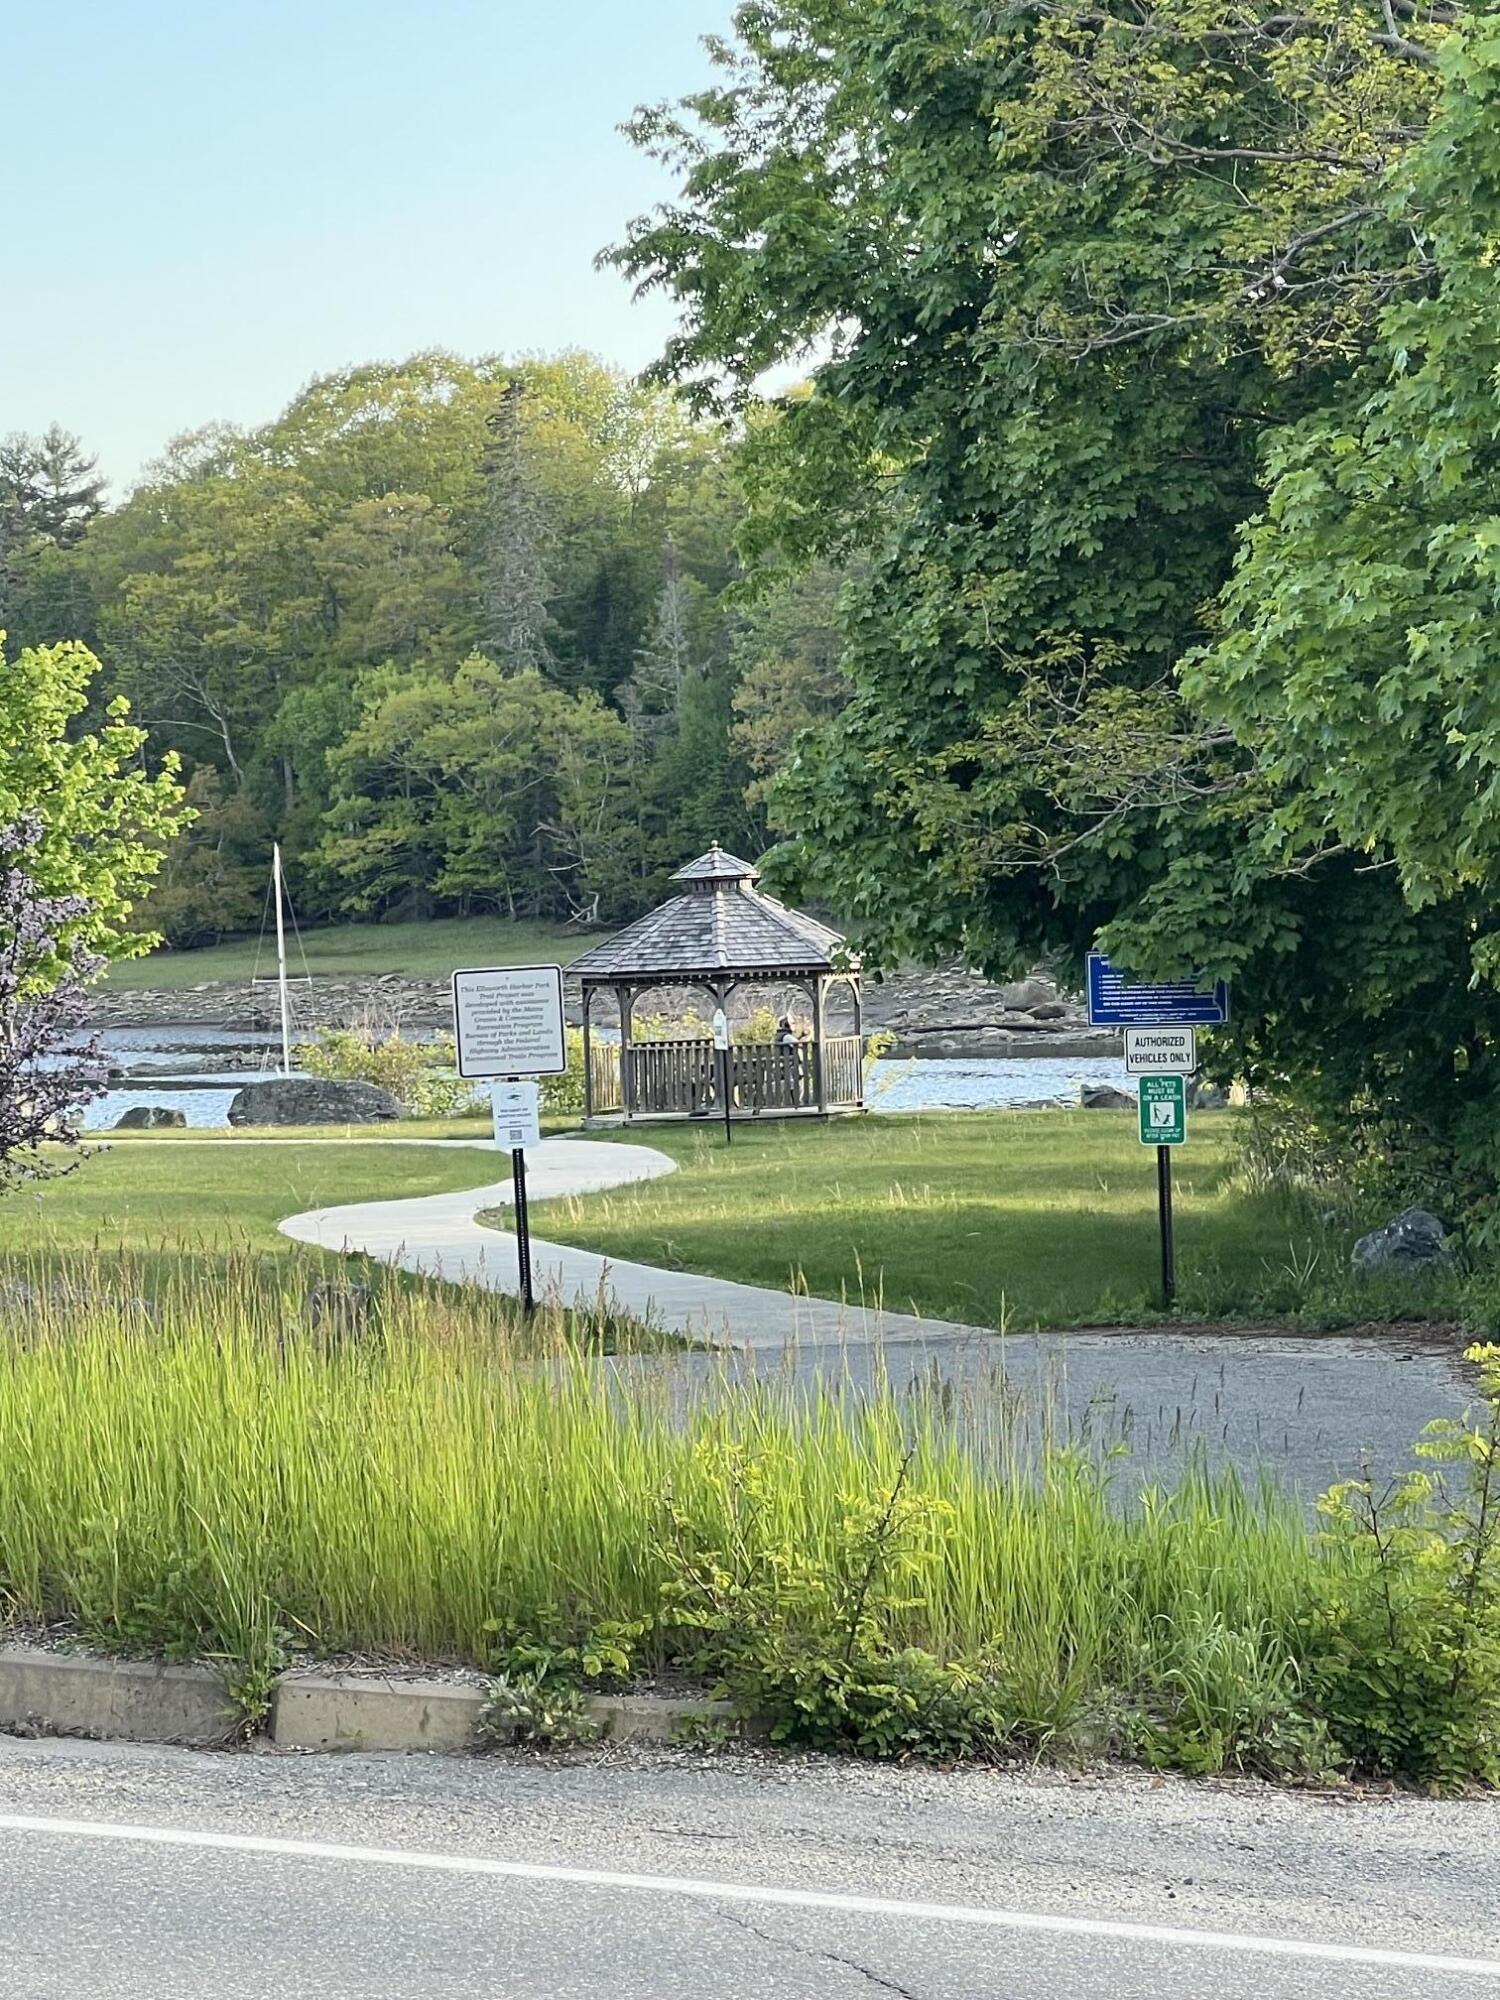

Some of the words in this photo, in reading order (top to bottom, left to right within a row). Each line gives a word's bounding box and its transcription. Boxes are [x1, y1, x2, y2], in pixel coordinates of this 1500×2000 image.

[1135, 1037, 1185, 1047] AUTHORIZED
[1129, 1052, 1167, 1063] VEHICLES
[1170, 1052, 1190, 1063] ONLY
